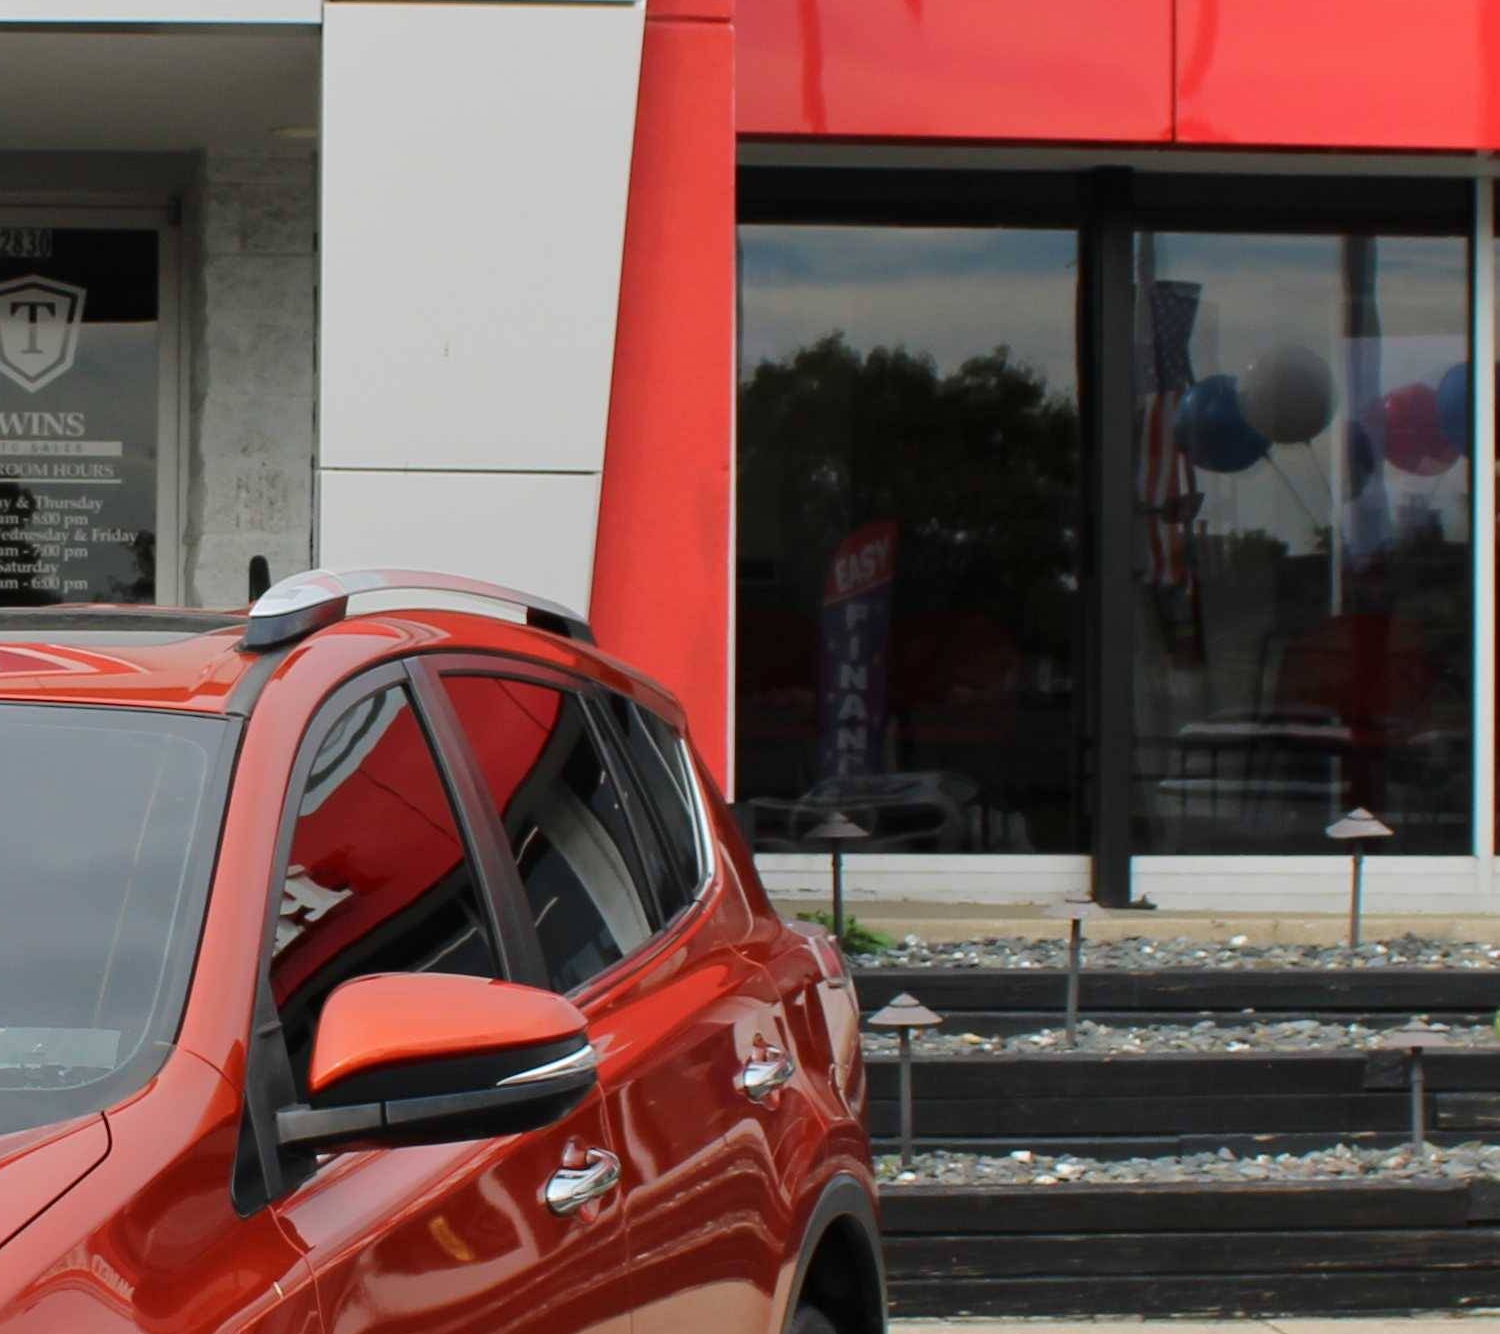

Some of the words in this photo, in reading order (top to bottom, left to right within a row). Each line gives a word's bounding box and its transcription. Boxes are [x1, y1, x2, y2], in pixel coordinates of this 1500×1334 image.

[10, 302, 56, 355] T
[53, 463, 115, 478] HOURS
[16, 496, 30, 510] &
[35, 495, 103, 513] Thursday
[64, 515, 89, 527] pm
[75, 529, 88, 542] &
[92, 528, 139, 545] Friday
[64, 547, 89, 560] pm
[834, 536, 891, 592] EASY
[64, 579, 89, 592] pm
